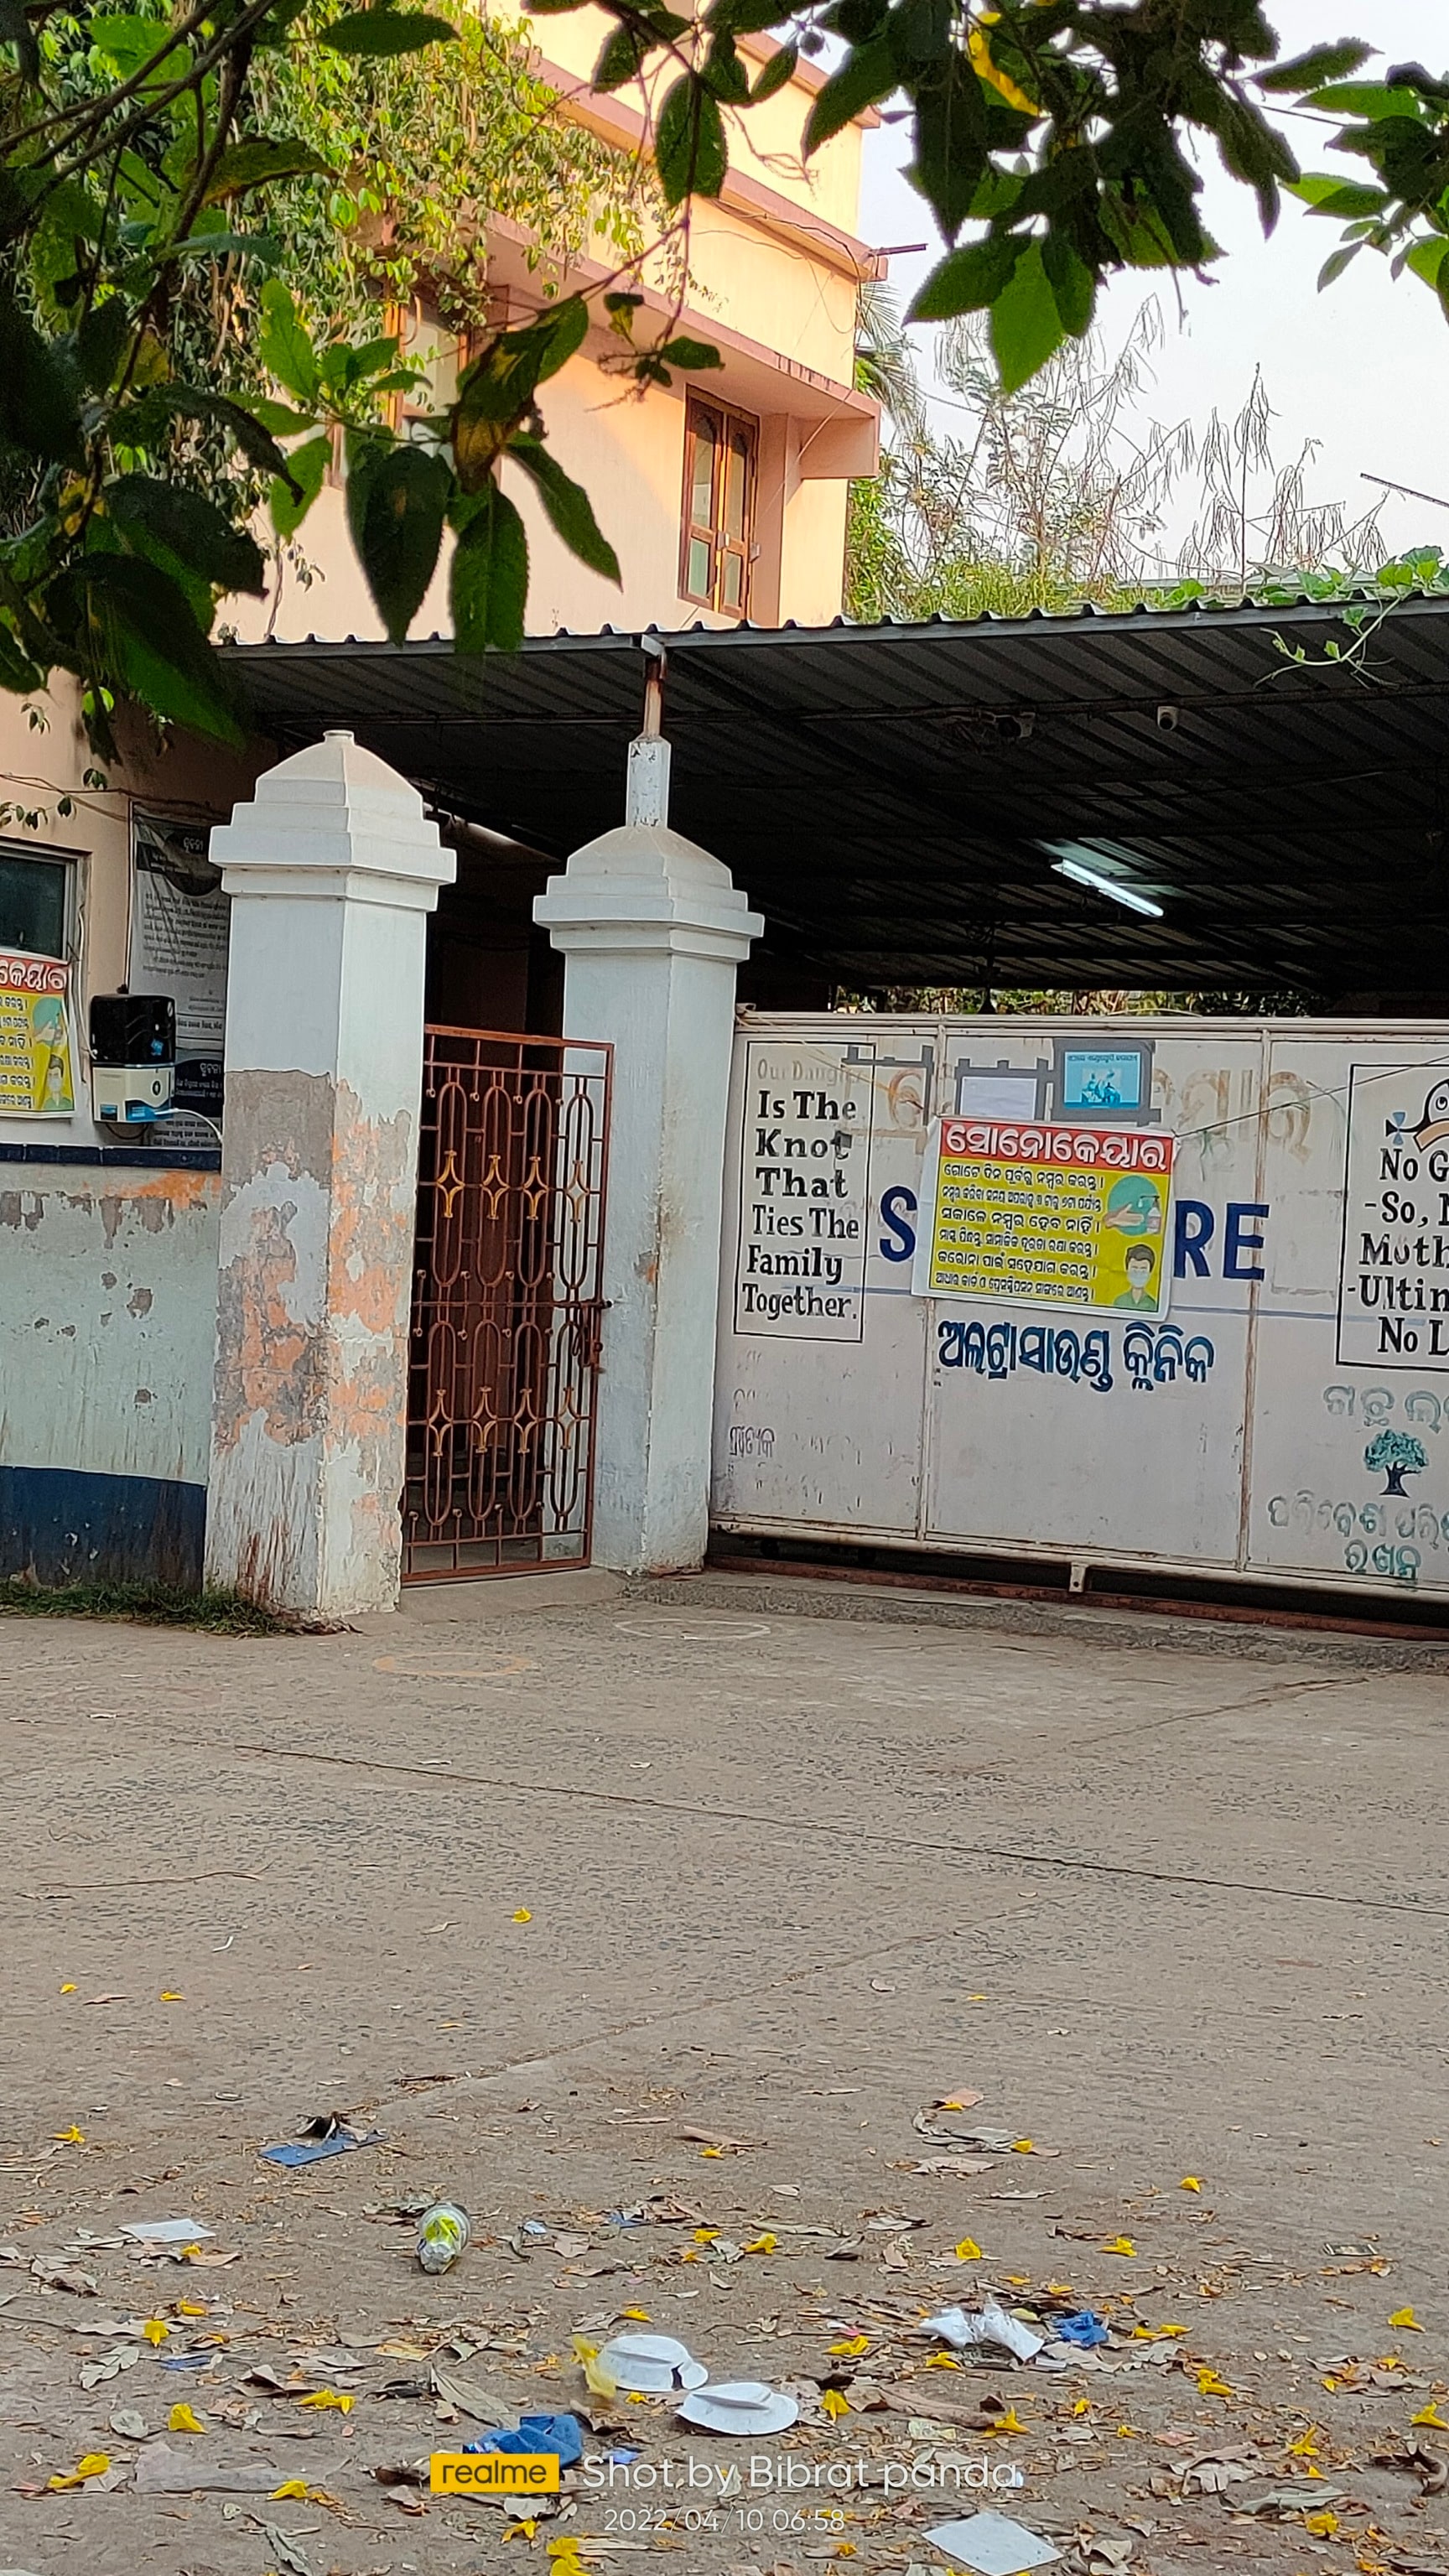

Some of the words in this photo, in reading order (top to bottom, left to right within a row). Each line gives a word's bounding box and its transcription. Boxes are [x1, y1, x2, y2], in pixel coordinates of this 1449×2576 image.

[756, 1090, 785, 1119] Is
[792, 1091, 857, 1121] The
[755, 1128, 853, 1160] Knot
[946, 1123, 1166, 1171] ସୋନୋକେୟାର
[944, 1163, 980, 1178] ଗୋଟେ
[984, 1162, 1001, 1179] ଦିନ
[1379, 1148, 1419, 1181] No
[1428, 1150, 1449, 1182] G
[756, 1167, 849, 1199] That
[752, 1204, 803, 1237] Ties
[809, 1208, 859, 1239] The
[1029, 1216, 1061, 1231] ହେବ
[937, 1250, 979, 1265] କରୋନା
[1173, 1200, 1271, 1282] RE
[1358, 1233, 1449, 1268] Moth
[746, 1244, 843, 1285] Family
[742, 1283, 858, 1322] Together.
[1377, 1317, 1419, 1353] No
[1428, 1319, 1449, 1355] L
